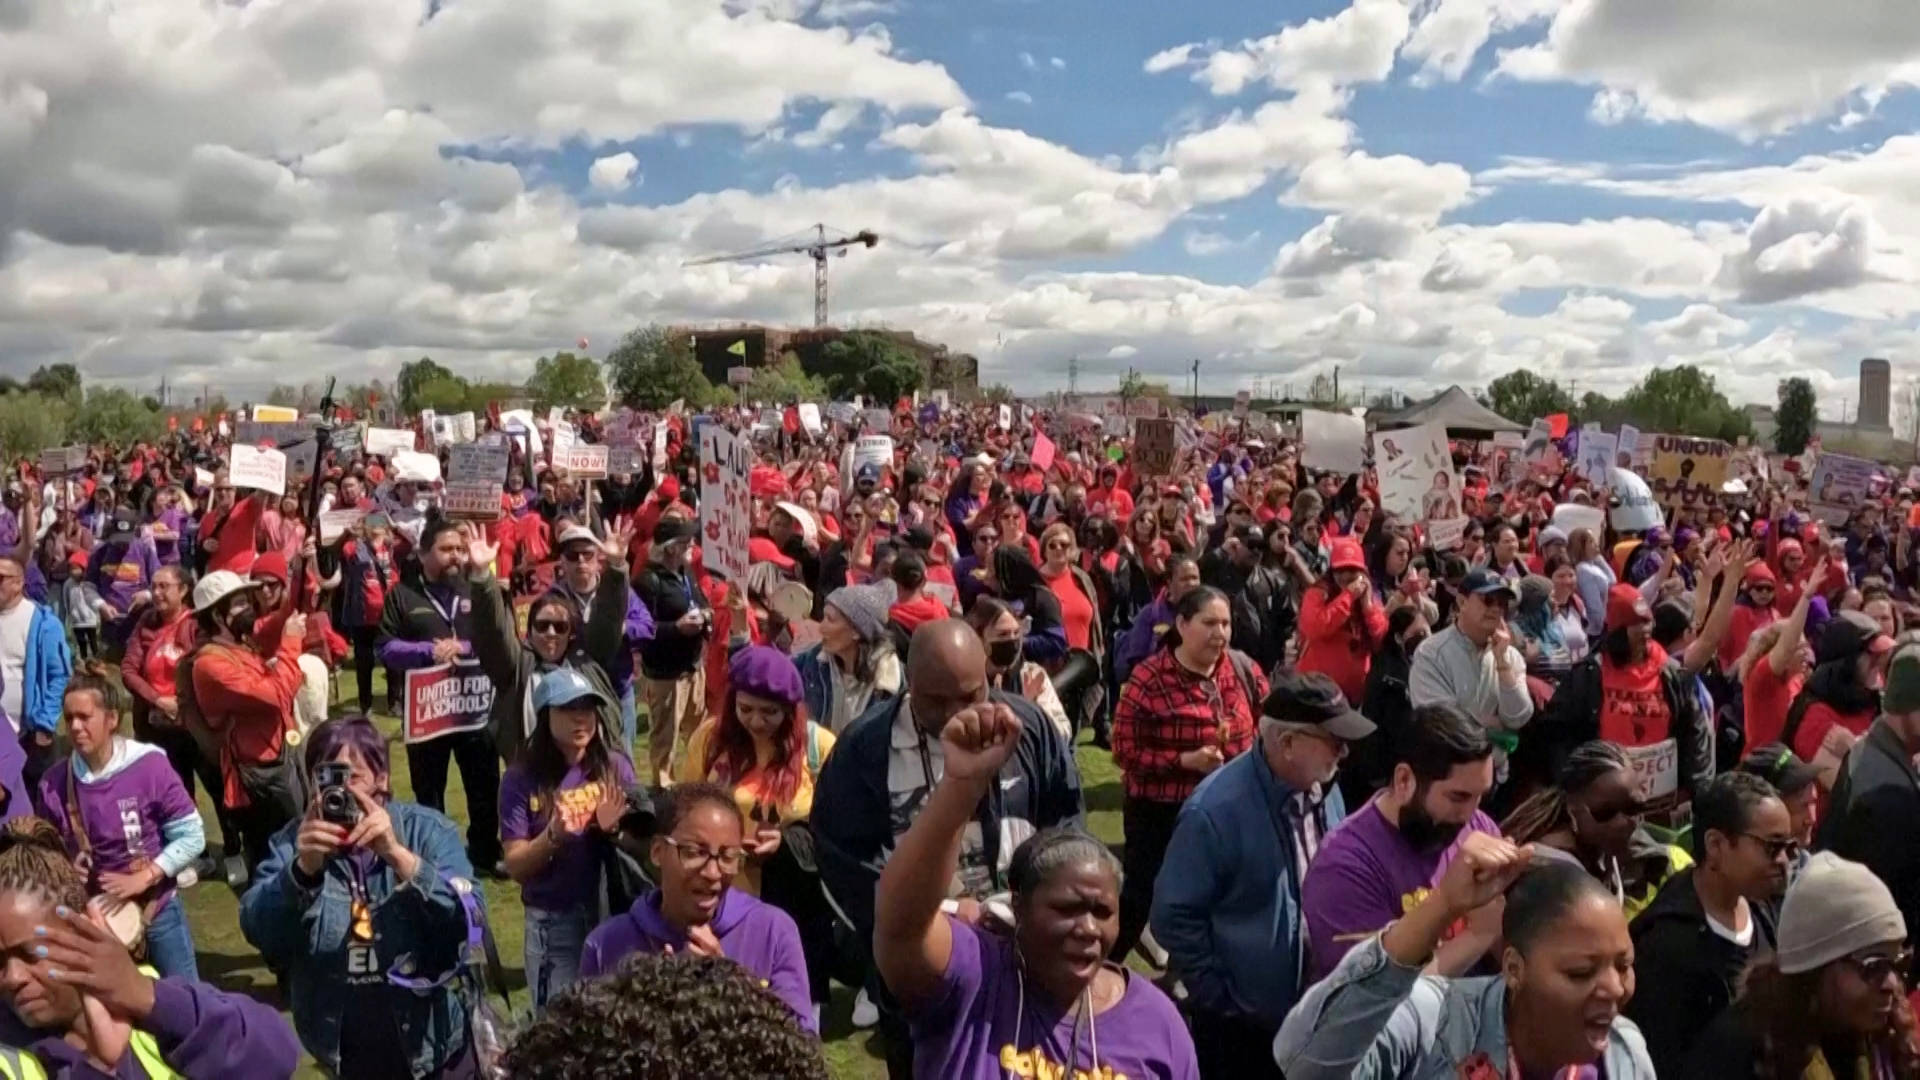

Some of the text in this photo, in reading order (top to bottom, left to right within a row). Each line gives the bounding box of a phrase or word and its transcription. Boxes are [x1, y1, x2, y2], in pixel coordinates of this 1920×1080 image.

[1656, 436, 1723, 458] UNION
[571, 457, 605, 468] NOW!
[416, 675, 491, 704] UNITED FOR
[416, 693, 489, 724] LA SCHOOLS
